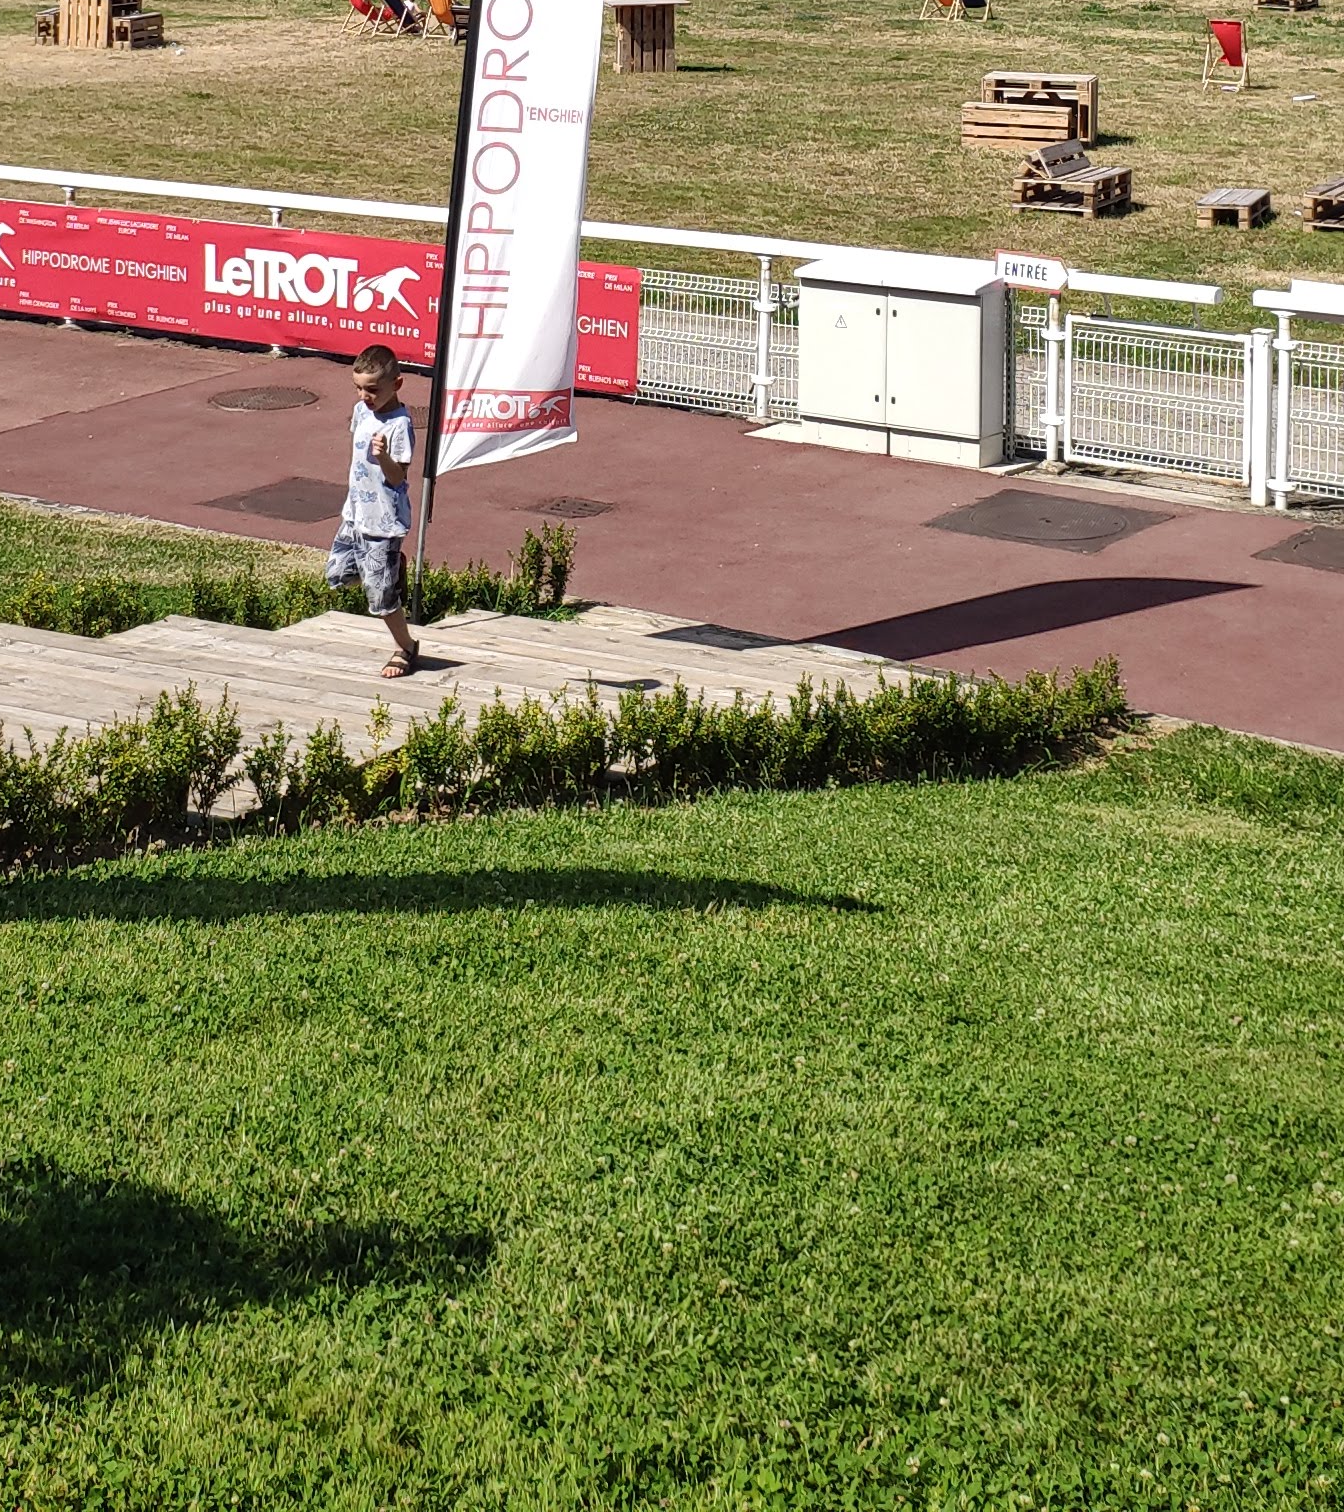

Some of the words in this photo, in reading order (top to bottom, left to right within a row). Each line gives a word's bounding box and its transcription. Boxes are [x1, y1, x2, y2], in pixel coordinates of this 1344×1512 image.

[22, 248, 110, 274] HIPPODROME
[115, 259, 187, 283] D'ENGHIEN
[204, 243, 358, 309] LeTROT
[1004, 262, 1048, 281] ENTRÉE
[204, 300, 231, 314] plus
[237, 305, 281, 321] qu'une
[288, 310, 333, 329] allure,
[340, 317, 363, 331] une
[370, 321, 420, 339] culture
[577, 316, 628, 338] GHIEN
